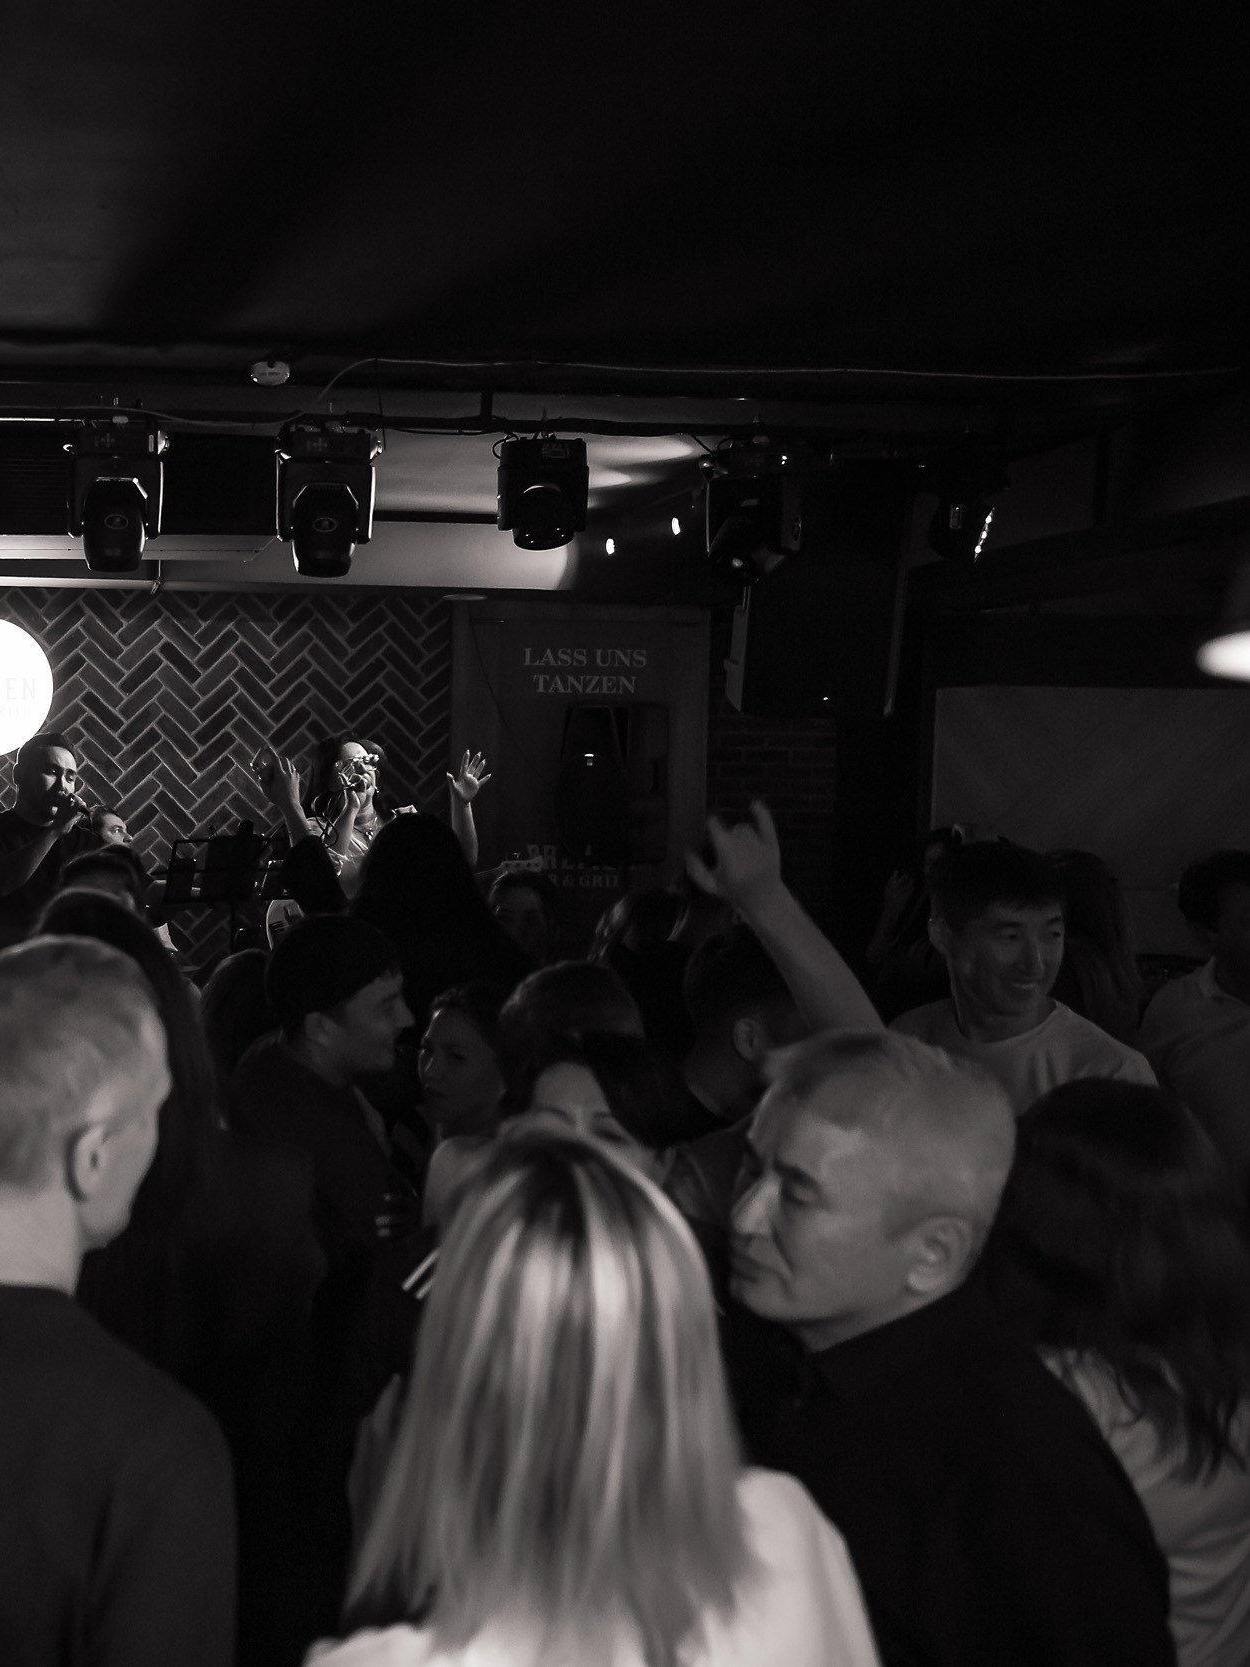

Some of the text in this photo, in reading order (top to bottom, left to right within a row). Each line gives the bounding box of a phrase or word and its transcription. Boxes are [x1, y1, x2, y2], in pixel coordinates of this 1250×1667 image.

[523, 648, 647, 668] LASS UNS
[533, 674, 636, 694] TANZEN
